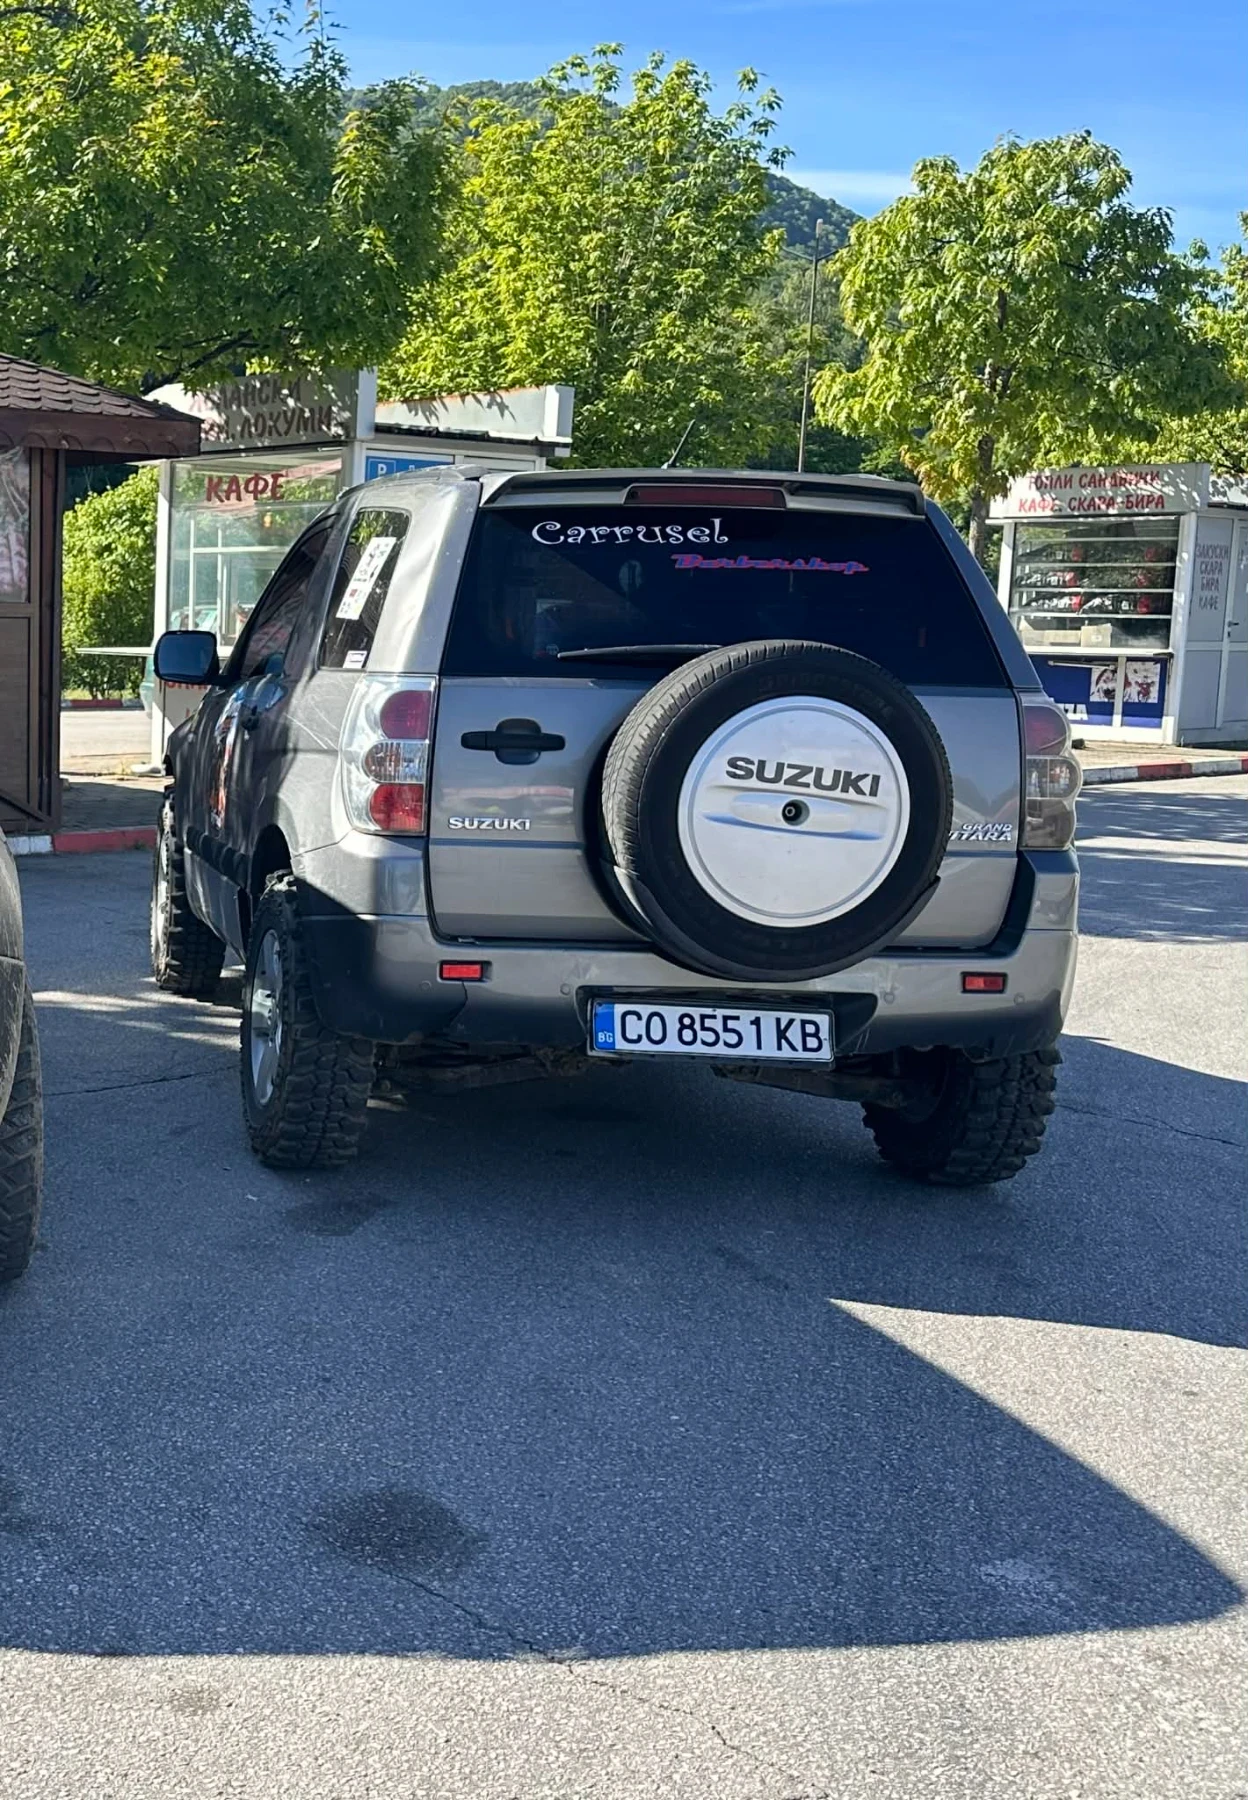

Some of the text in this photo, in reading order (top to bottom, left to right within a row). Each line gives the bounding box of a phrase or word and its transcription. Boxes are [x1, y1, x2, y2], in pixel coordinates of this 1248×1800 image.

[206, 472, 285, 503] КАФЕ
[532, 518, 728, 545] Carrusel
[726, 756, 881, 797] SUZUKI
[448, 816, 531, 831] SUZUKI
[962, 823, 1013, 832] GRAND
[948, 830, 1012, 841] ITARA
[598, 1032, 613, 1043] BG
[677, 1013, 763, 1050] 8551
[775, 1017, 823, 1053] KB
